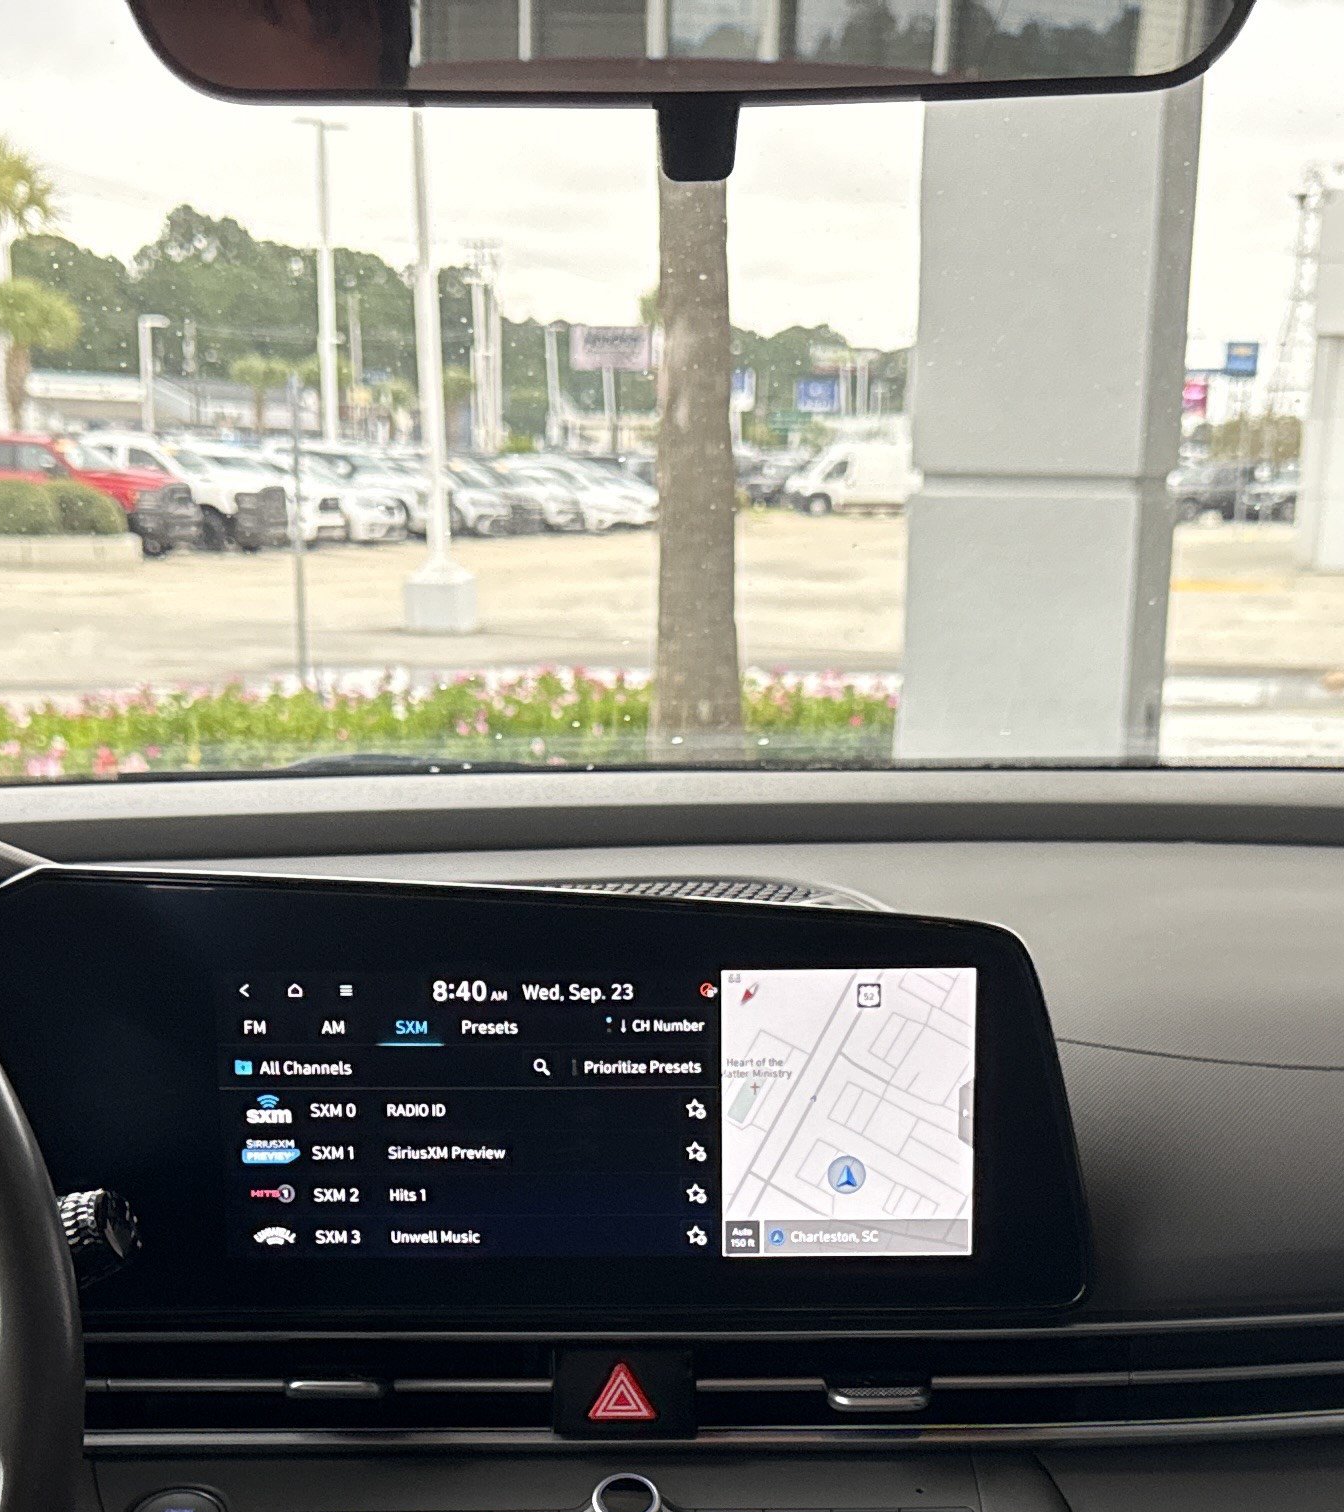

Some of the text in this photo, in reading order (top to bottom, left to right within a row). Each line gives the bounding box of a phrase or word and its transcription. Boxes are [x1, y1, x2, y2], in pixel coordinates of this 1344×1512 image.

[432, 980, 634, 1003] 8:40 AM Wed, Sep. 23
[243, 1020, 267, 1035] FM
[321, 1020, 346, 1035] AM
[395, 1020, 428, 1035] SXM
[461, 1020, 518, 1035] Presets
[632, 1019, 704, 1032] CH Number
[259, 1060, 353, 1075] All Channels
[584, 1060, 702, 1074] Prioritize Presets
[726, 1058, 784, 1067] Heart of the
[723, 1069, 792, 1080] atter Ministry
[310, 1103, 356, 1118] SXM 0
[386, 1103, 446, 1117] RADIO ID
[245, 1139, 295, 1149] SIRIUSXM
[312, 1146, 354, 1160] SXM 1
[388, 1146, 505, 1160] SiriusXM Preview
[251, 1189, 281, 1198] HITS
[313, 1188, 360, 1202] SXM 2
[389, 1188, 427, 1202] Hits 1
[315, 1230, 361, 1244] SXM 3
[391, 1230, 480, 1244] Unwell Music
[732, 1228, 753, 1236] Auto
[790, 1230, 879, 1245] Charleston, SC
[731, 1239, 746, 1247] 150
